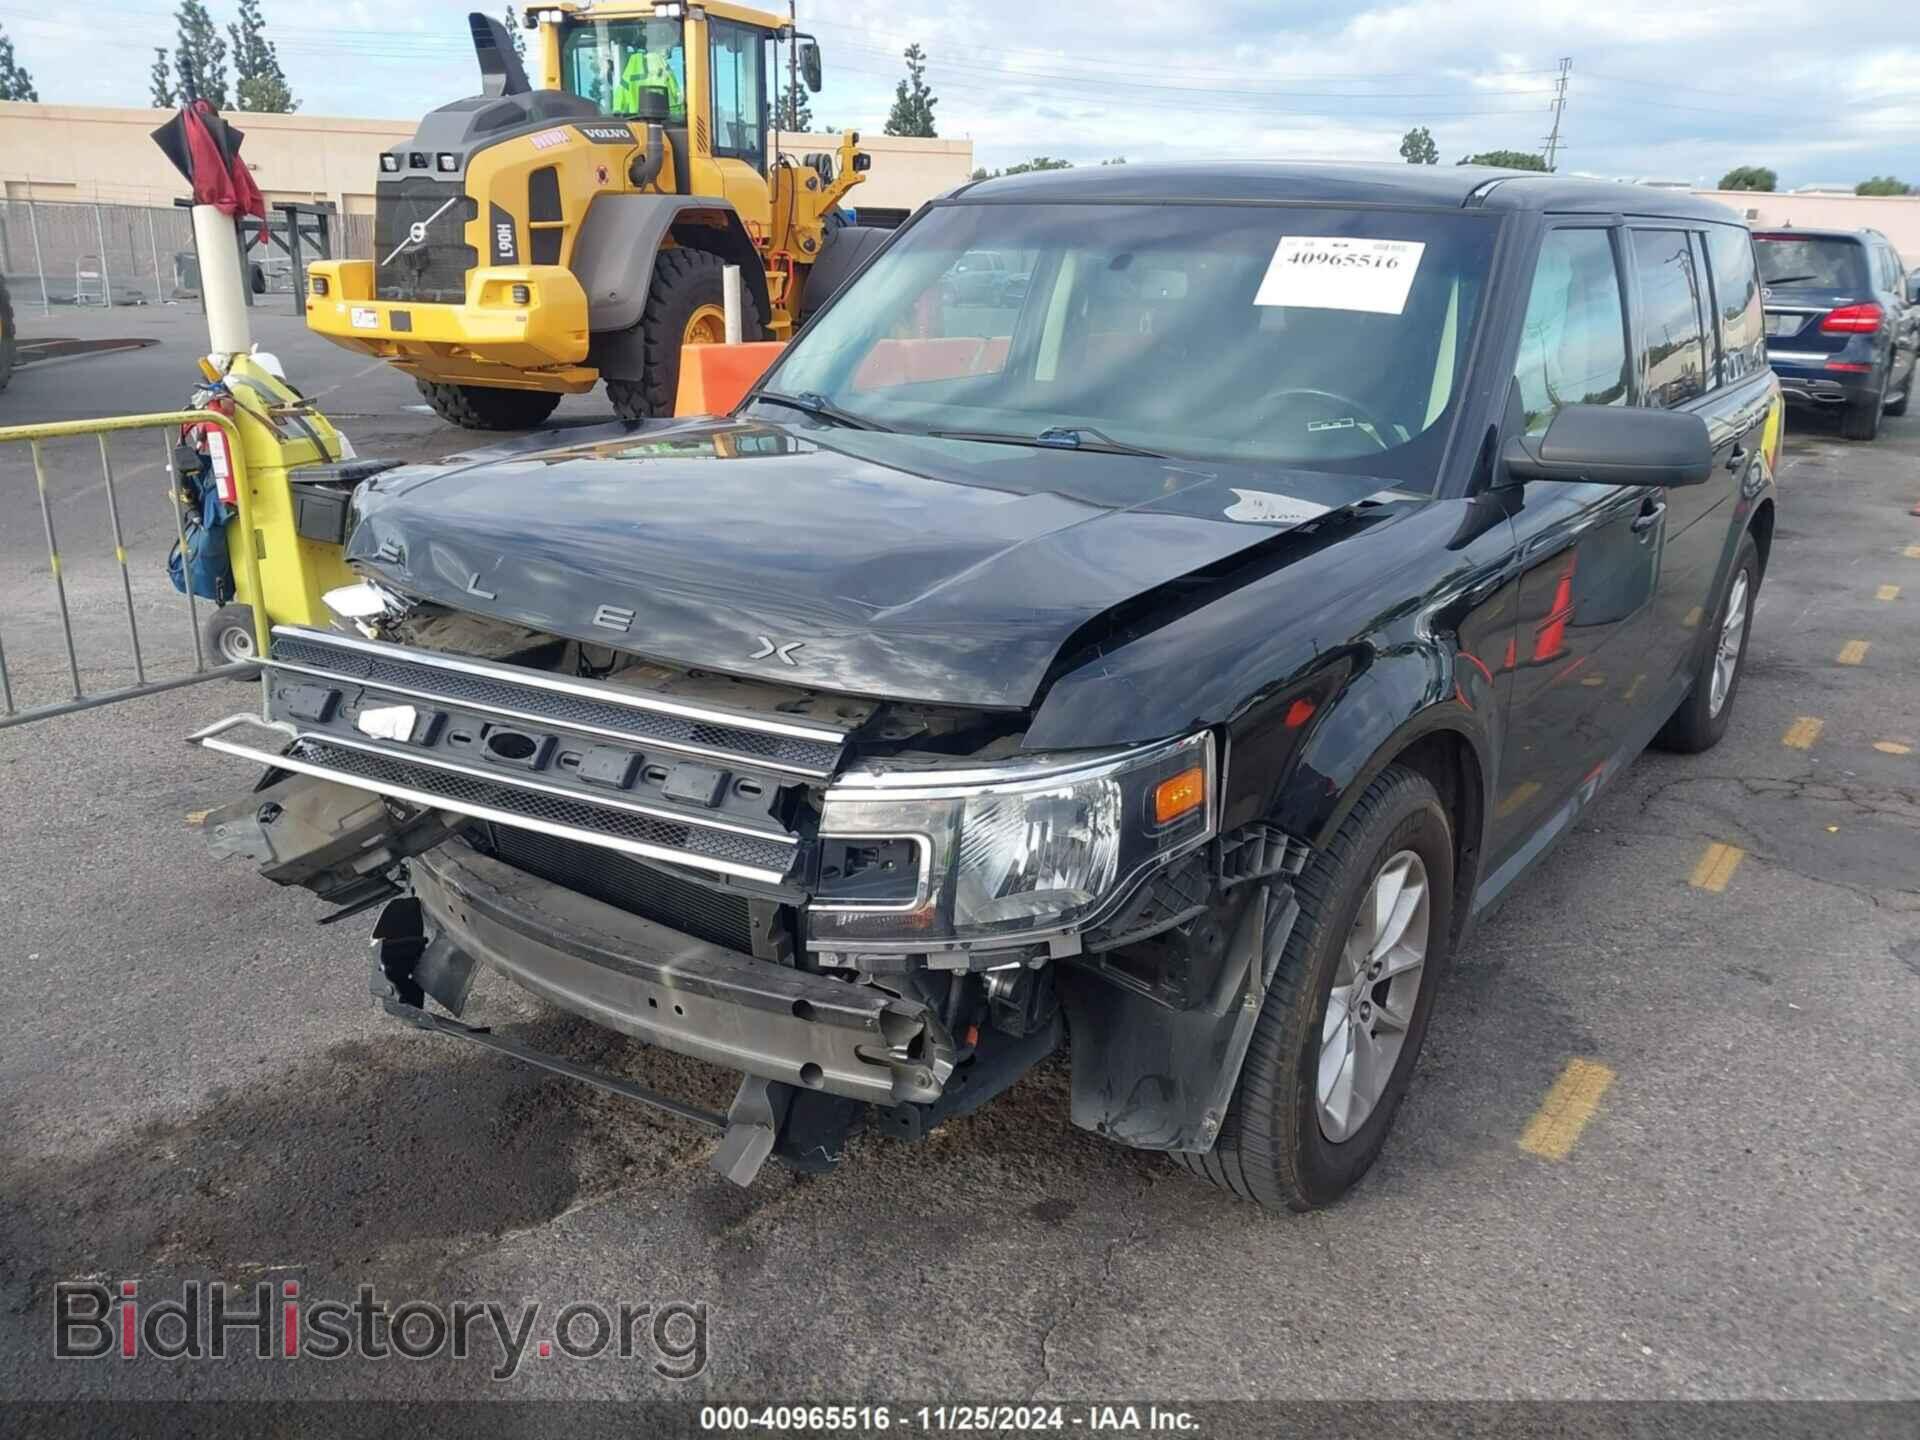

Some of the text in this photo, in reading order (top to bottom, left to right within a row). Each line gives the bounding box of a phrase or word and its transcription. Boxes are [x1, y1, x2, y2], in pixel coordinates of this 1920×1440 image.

[584, 128, 631, 138] VOLVO
[496, 224, 514, 258] L90H
[1287, 252, 1400, 269] 40965516
